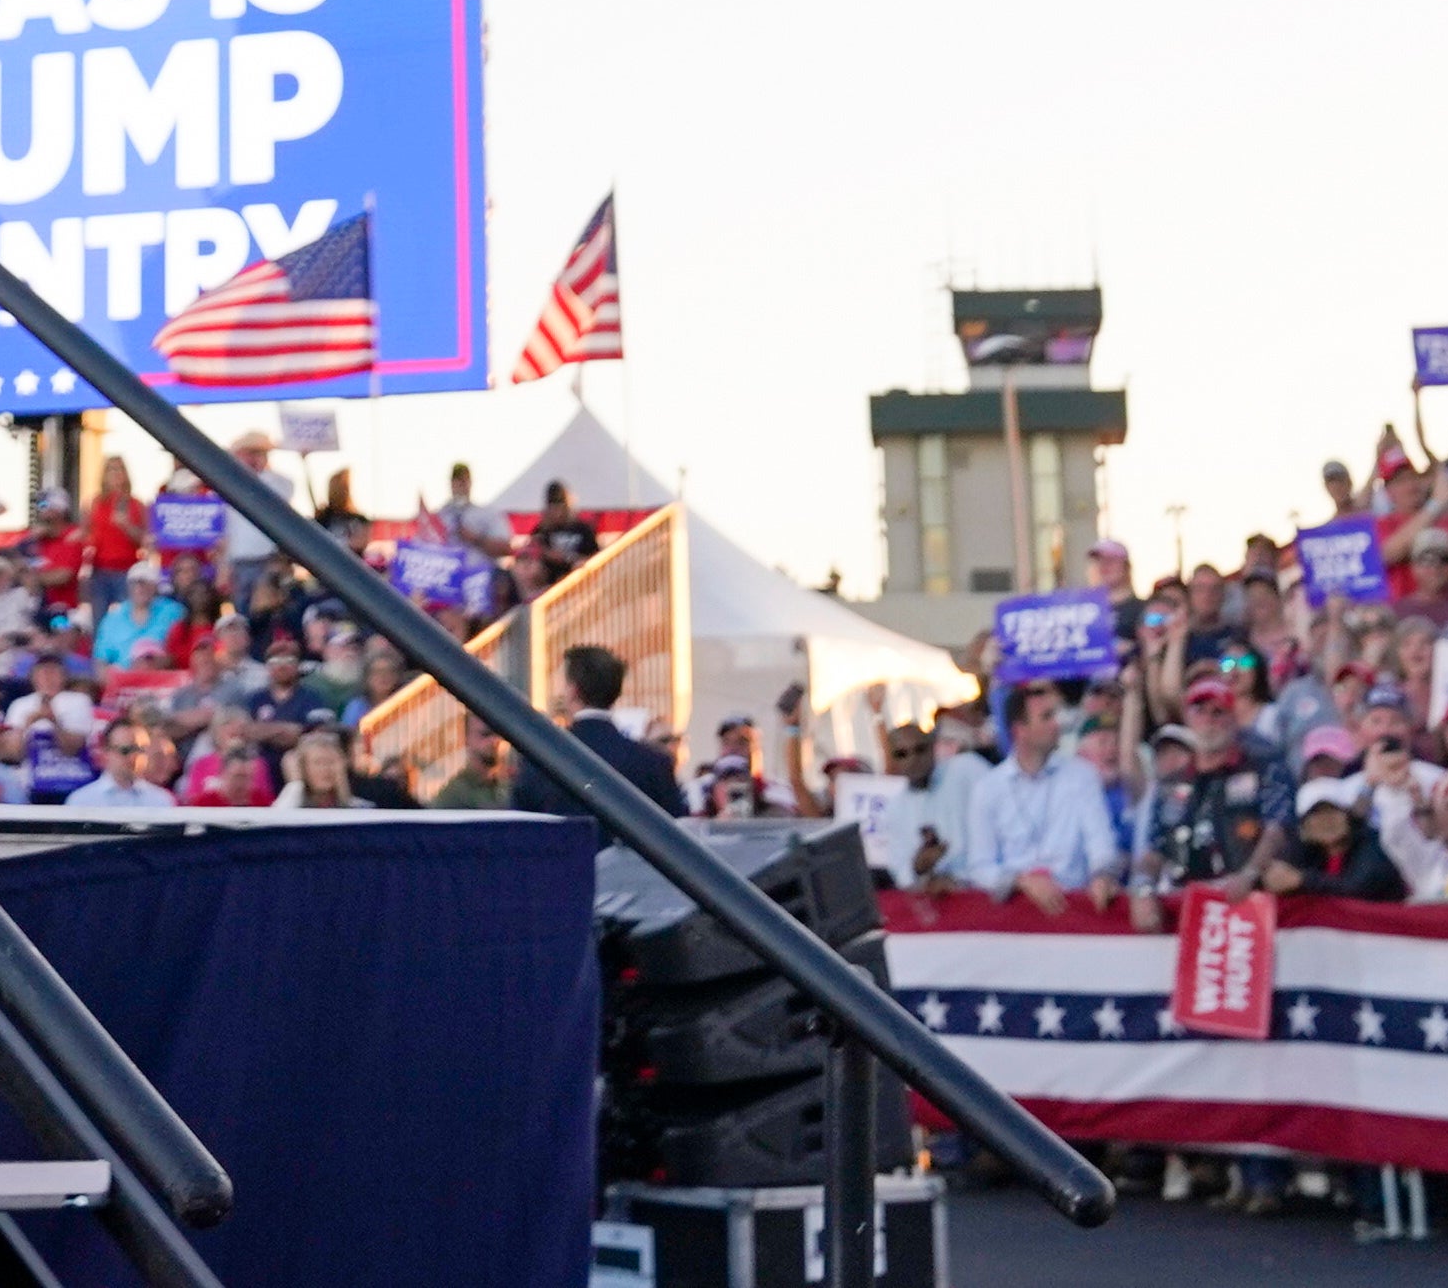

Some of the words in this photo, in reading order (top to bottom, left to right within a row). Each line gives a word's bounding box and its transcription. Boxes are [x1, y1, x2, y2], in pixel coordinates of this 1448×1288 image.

[1002, 603, 1100, 637] TRUMP
[1193, 900, 1229, 1014] WITCH
[1224, 913, 1256, 1011] HUNT
